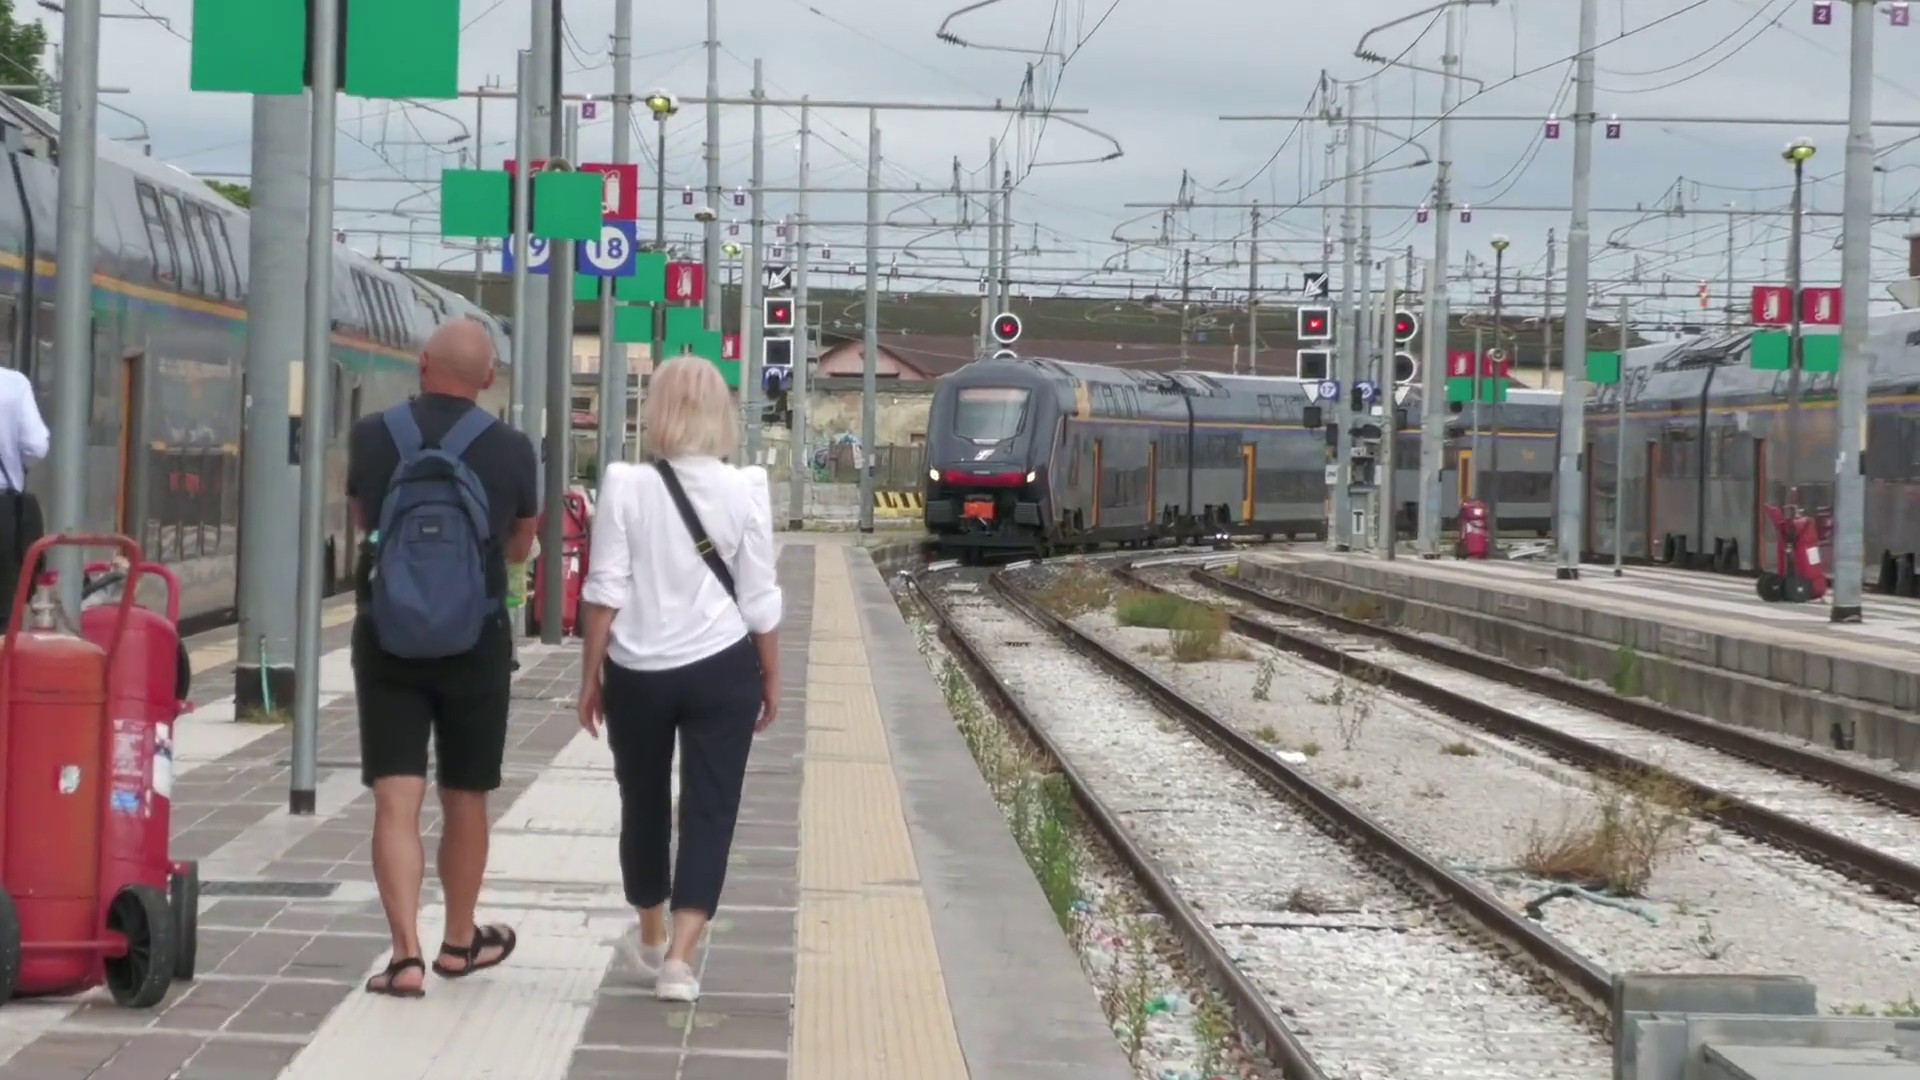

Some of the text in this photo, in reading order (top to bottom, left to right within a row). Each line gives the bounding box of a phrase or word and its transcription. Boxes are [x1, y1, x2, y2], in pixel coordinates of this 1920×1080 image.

[1818, 8, 1827, 21] 2
[1895, 9, 1904, 23] 2
[595, 237, 623, 260] 18
